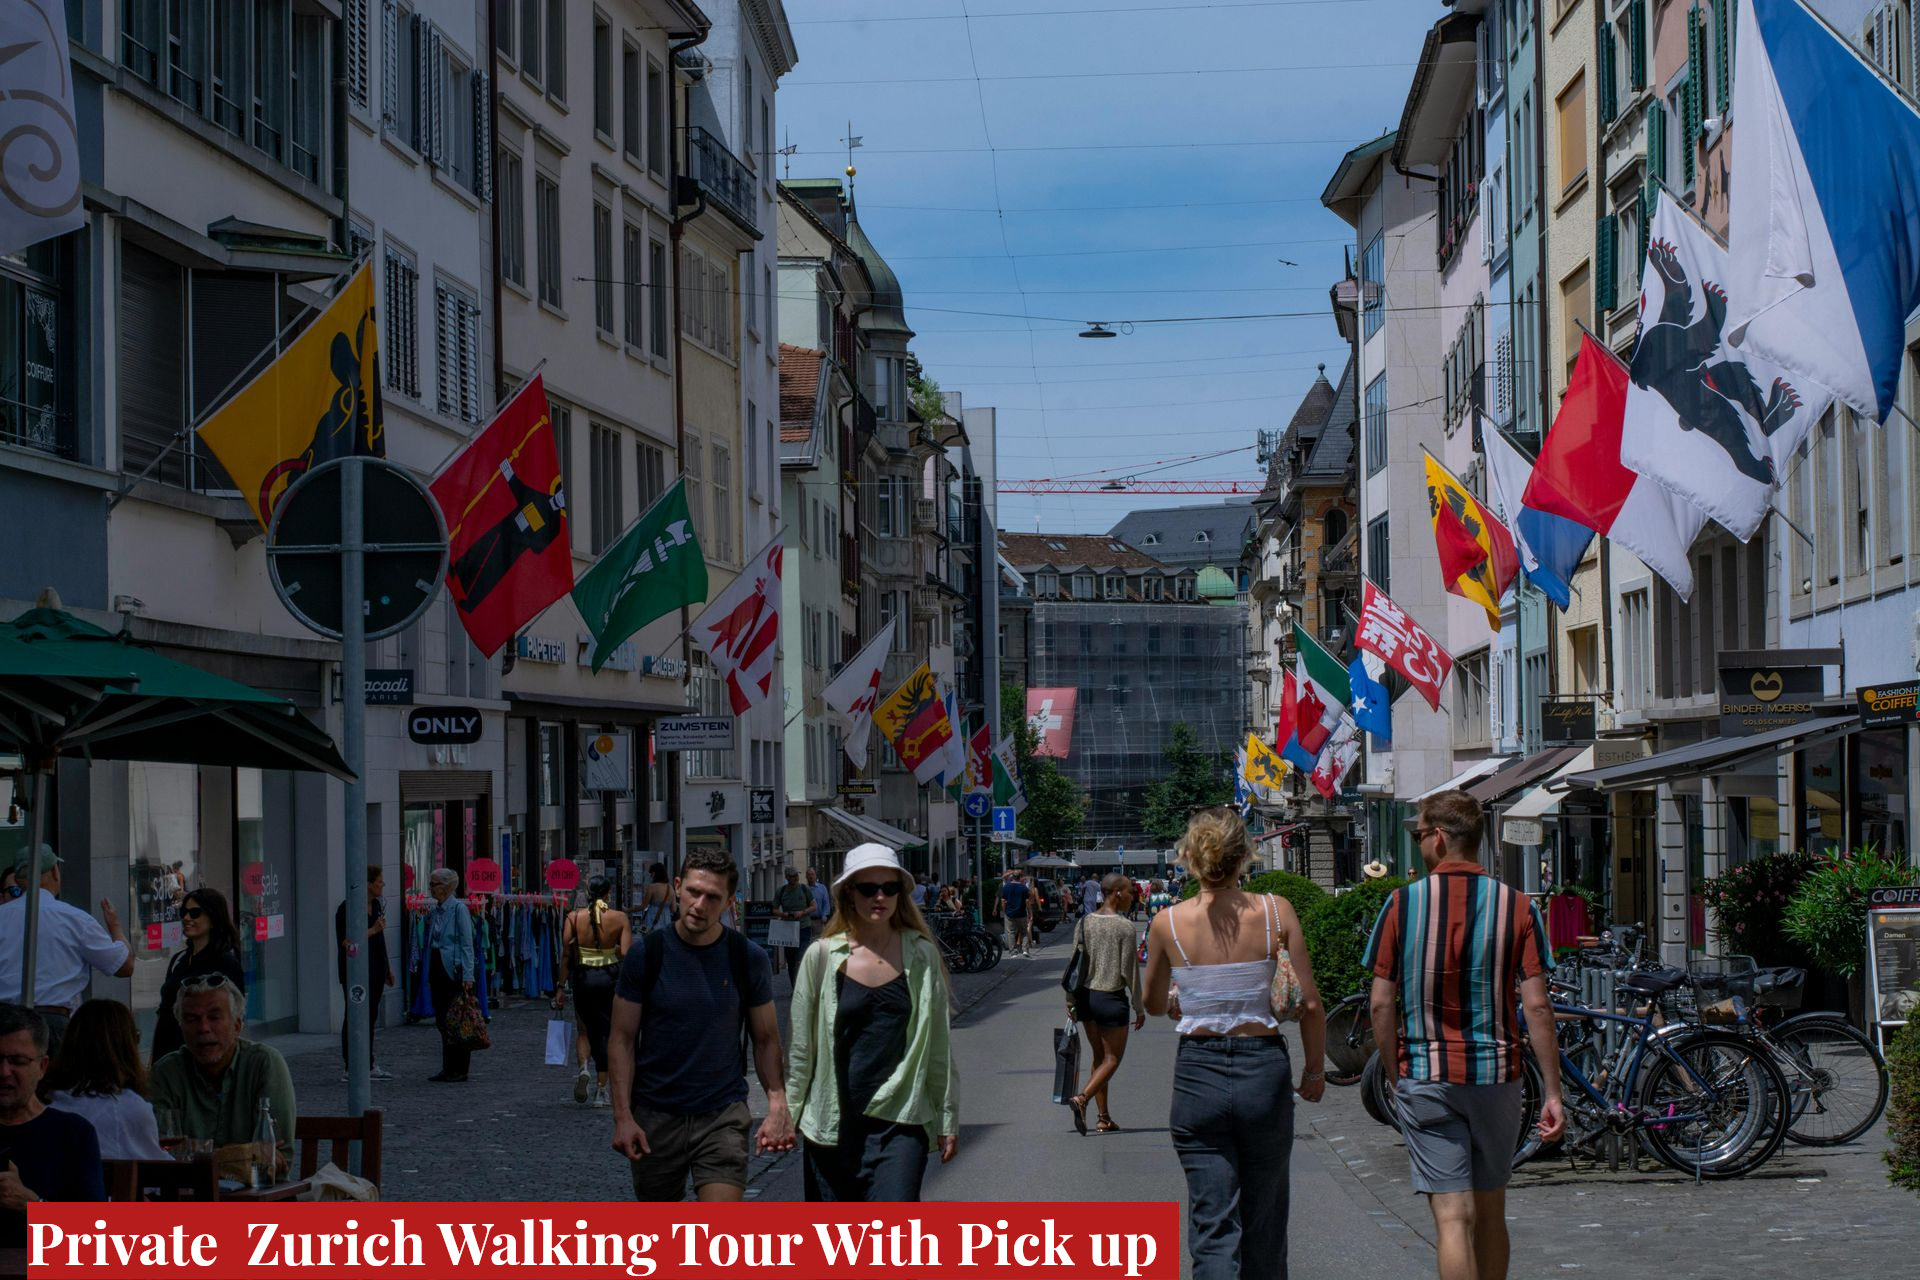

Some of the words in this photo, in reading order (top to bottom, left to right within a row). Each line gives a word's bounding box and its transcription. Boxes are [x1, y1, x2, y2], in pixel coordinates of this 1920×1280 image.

[364, 678, 409, 692] acadi
[1877, 688, 1910, 698] FASHION
[1722, 704, 1763, 713] BINDER
[412, 716, 478, 734] ONLY
[660, 722, 729, 731] ZUMSTEIN
[261, 863, 279, 896] sale
[471, 871, 480, 881] 15
[482, 871, 496, 881] CHF
[562, 871, 575, 880] CHF
[1871, 889, 1920, 903] COIFF
